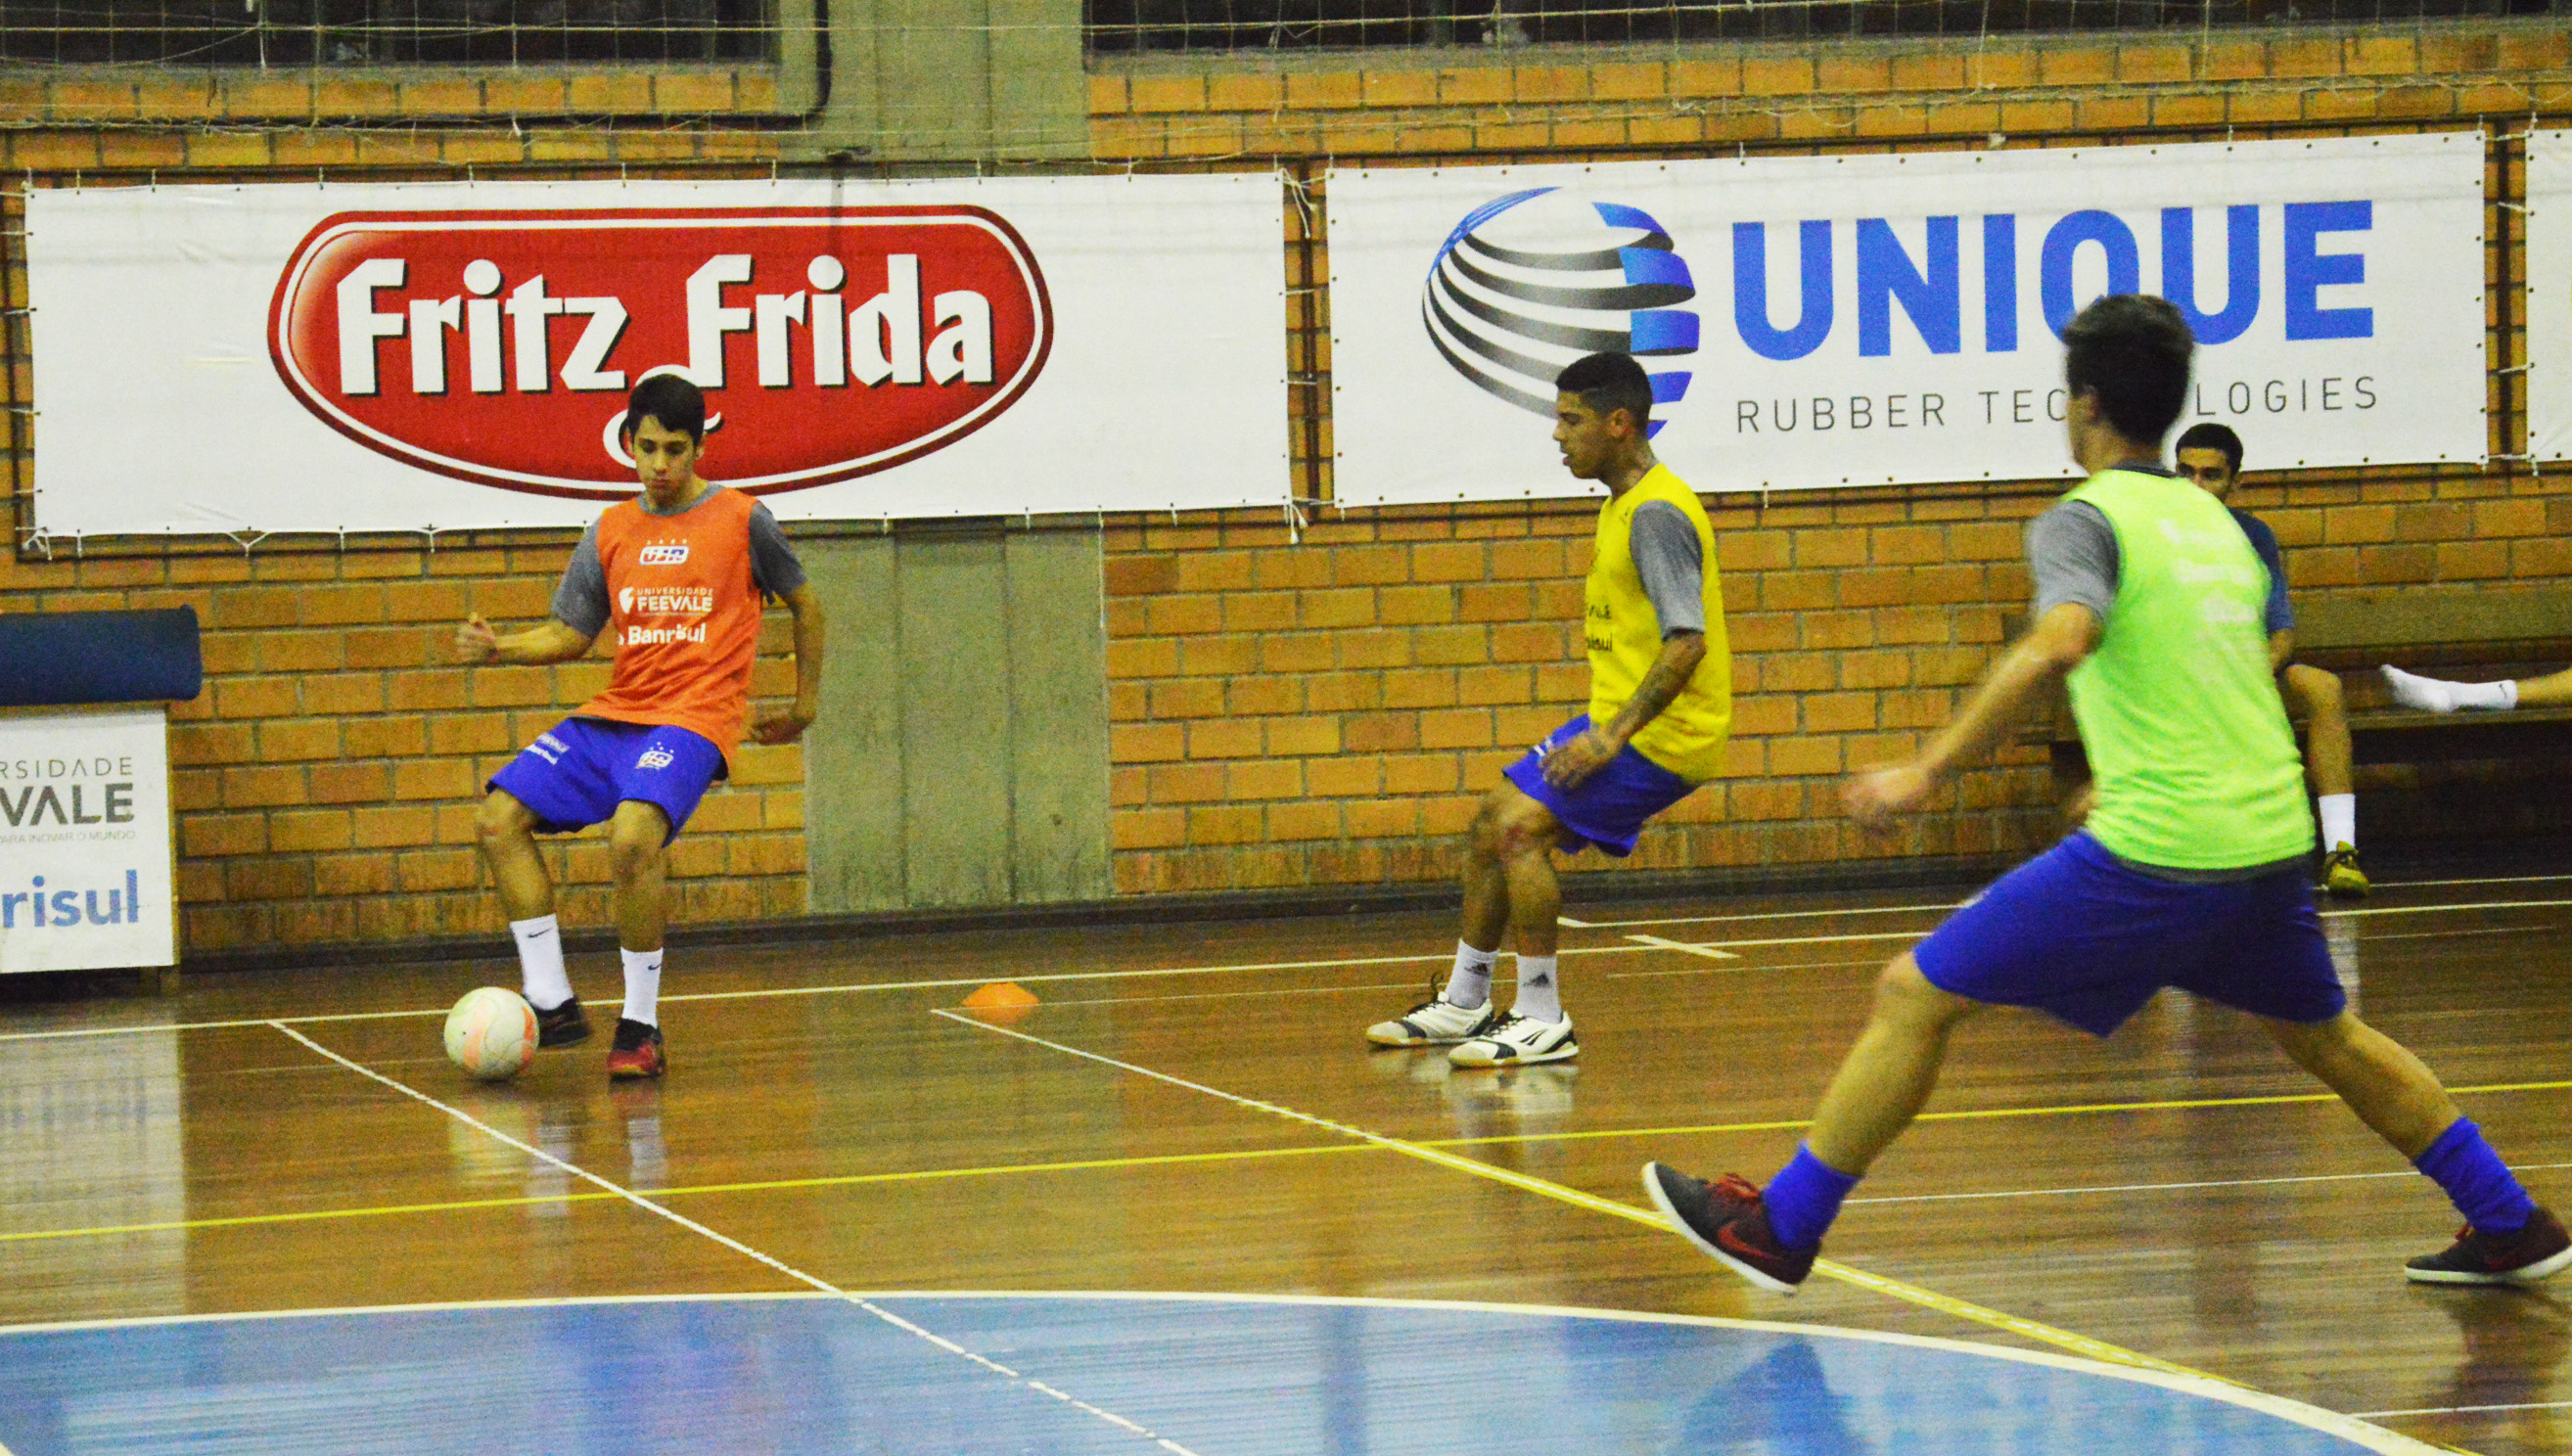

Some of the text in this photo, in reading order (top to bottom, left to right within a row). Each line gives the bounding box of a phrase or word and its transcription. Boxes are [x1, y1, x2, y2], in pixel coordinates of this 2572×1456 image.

[1732, 200, 2373, 361] UNIQUE
[337, 253, 995, 395] Fritz Frida
[1736, 376, 2377, 433] RUBBER TECLOGIES
[637, 586, 713, 597] UNIVERSIDADE
[637, 595, 713, 613] FEEVALE
[1, 869, 139, 929] risul
